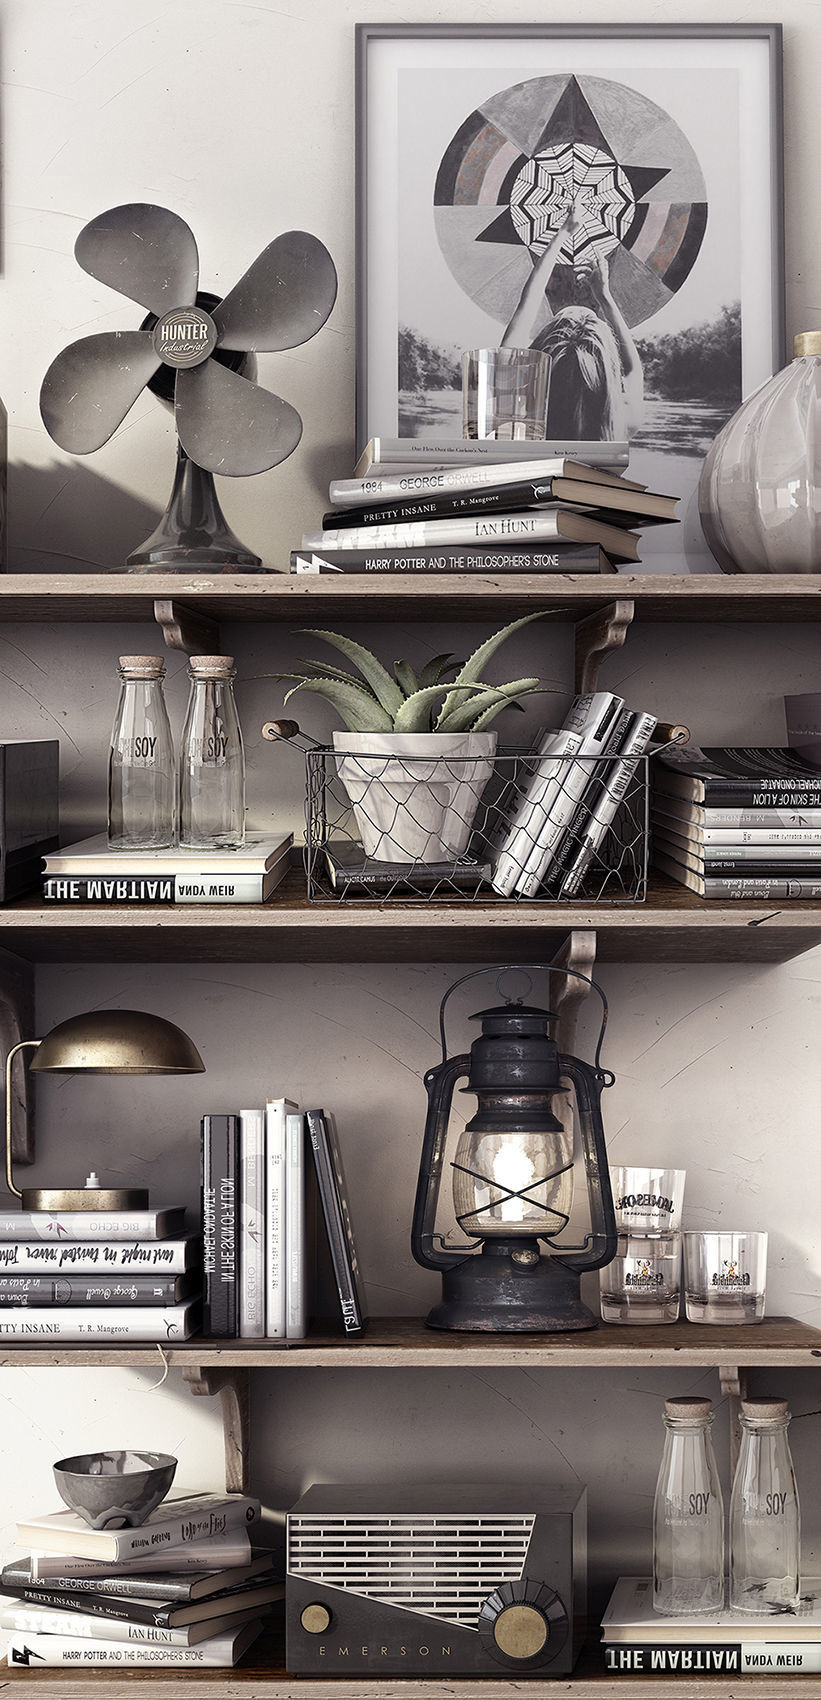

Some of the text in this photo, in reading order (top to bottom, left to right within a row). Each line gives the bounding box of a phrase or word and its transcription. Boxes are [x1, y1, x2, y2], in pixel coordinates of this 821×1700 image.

[161, 323, 208, 341] HUNTER
[160, 339, 209, 352] Industrial
[361, 481, 383, 494] 1984
[399, 471, 491, 490] GEORGE ORWELL
[469, 495, 500, 505] Mangrove
[363, 503, 437, 522] PRETTY INSANE
[475, 518, 537, 536] IAN HUNT
[365, 554, 559, 570] HARRY POTTER AND THE PHILOSOPHER'S STONE
[135, 736, 157, 757] SOY
[207, 736, 229, 757] SOY
[760, 779, 821, 790] ICHAEL ONDAATJE
[753, 793, 772, 805] LION
[772, 793, 778, 805] A
[778, 793, 790, 805] OF
[790, 793, 808, 806] SKIN
[89, 1222, 140, 1232] BIG ECHO
[25, 1247, 58, 1264] river
[60, 1247, 100, 1267] twisted
[103, 1246, 118, 1266] in
[121, 1243, 151, 1265] night
[9, 1279, 31, 1290] Paris
[7, 1293, 29, 1305] Down
[86, 1285, 138, 1300] George Orwell
[21, 1323, 61, 1334] INSANE
[78, 1324, 129, 1334] T. R. Mangrove
[688, 1492, 710, 1516] SOY
[766, 1492, 787, 1516] SOY
[58, 1577, 132, 1594] GEORGE ORWELL
[24, 1590, 81, 1608] PRETTY INSANE
[105, 1607, 129, 1618] Mangrove
[128, 1625, 174, 1642] IAN HUNT
[62, 1651, 204, 1661] HARRY POTTER AND THE PHILOSOPHER'S STONE
[320, 1646, 451, 1656] EMERSON
